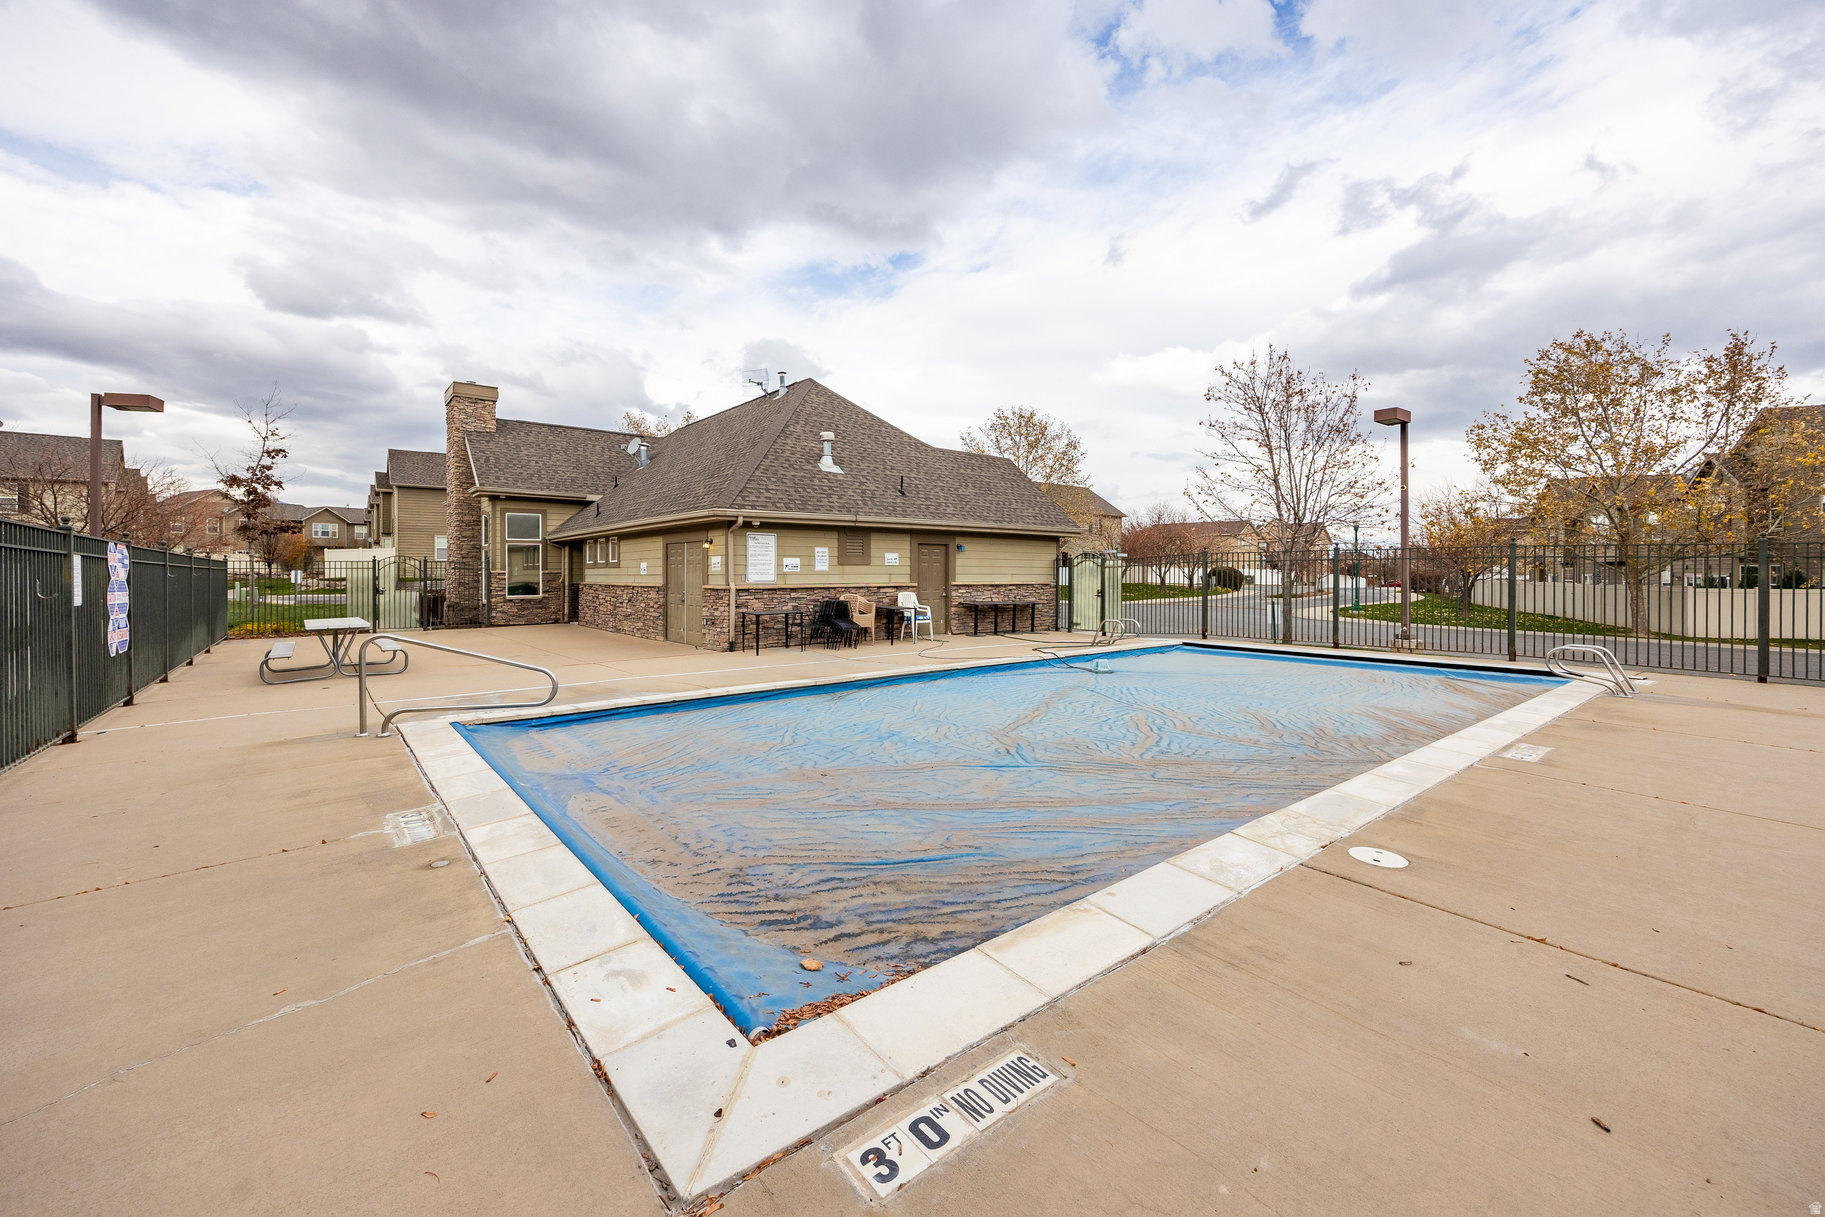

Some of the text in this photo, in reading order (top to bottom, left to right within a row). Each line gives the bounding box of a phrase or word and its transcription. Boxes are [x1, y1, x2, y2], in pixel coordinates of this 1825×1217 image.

[859, 1055, 1050, 1184] 3 FT 0 IN NO DIVING
